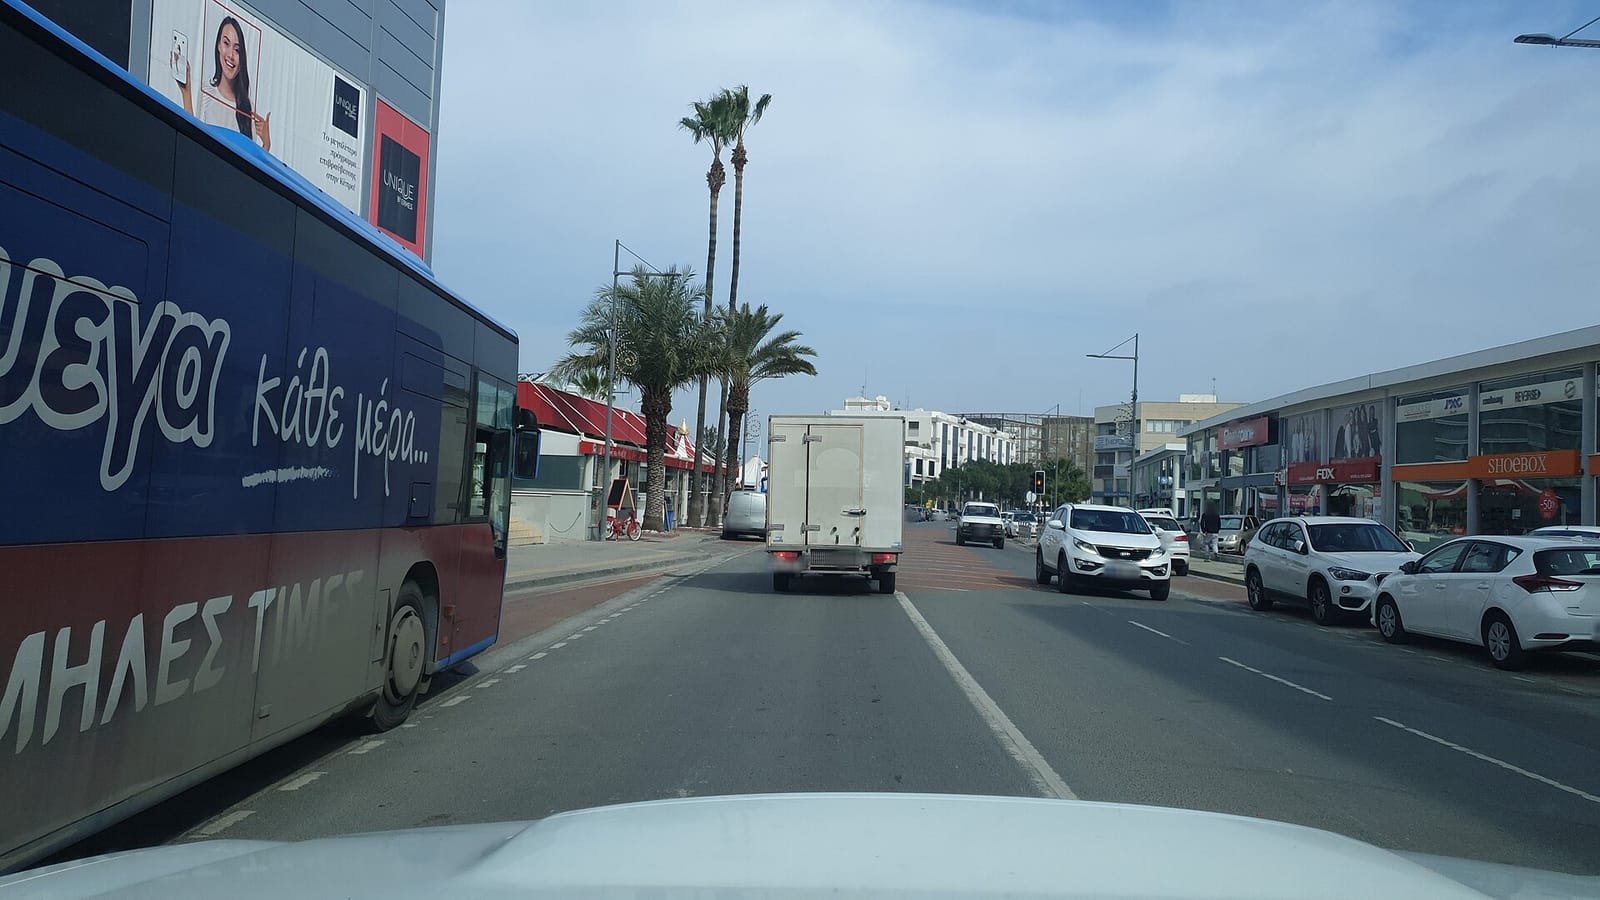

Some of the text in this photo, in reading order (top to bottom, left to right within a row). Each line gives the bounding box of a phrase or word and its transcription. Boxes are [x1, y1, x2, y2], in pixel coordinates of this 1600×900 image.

[383, 169, 414, 201] UNIQUE
[252, 346, 345, 449] κάθε
[1316, 468, 1335, 480] FOX
